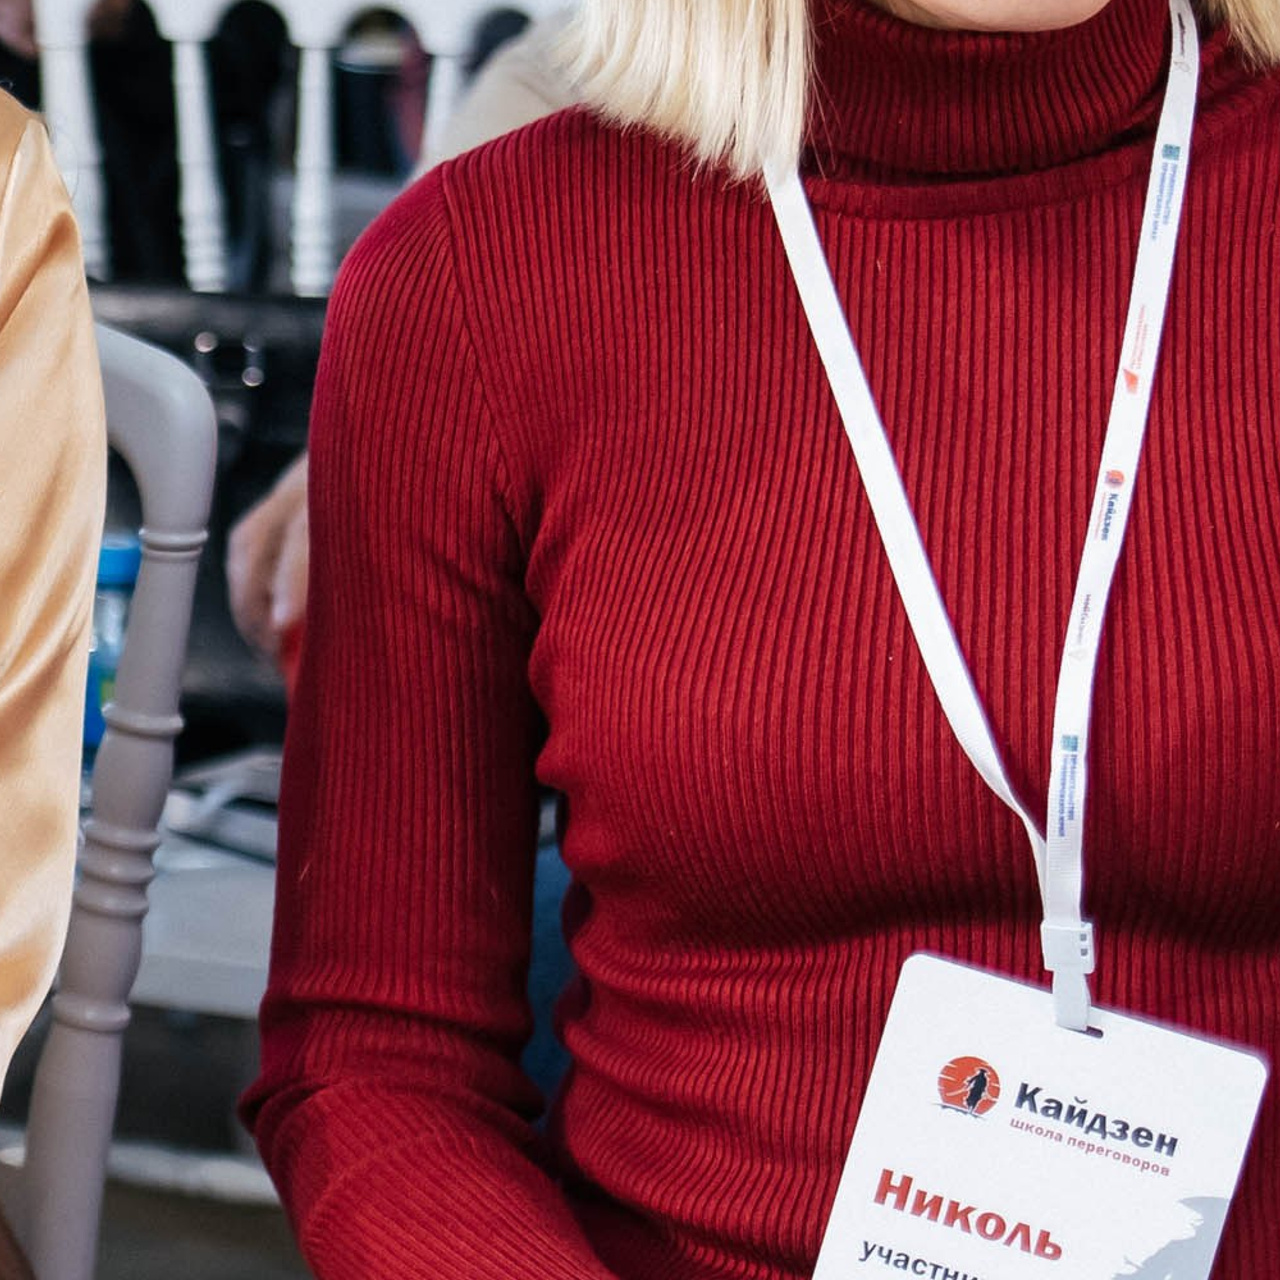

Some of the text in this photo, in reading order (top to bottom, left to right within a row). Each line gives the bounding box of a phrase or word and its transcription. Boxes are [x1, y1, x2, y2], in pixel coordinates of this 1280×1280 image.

[1009, 1117, 1171, 1177] школа переговоров
[1013, 1081, 1179, 1157] Кайдзен
[873, 1168, 1064, 1262] Николь
